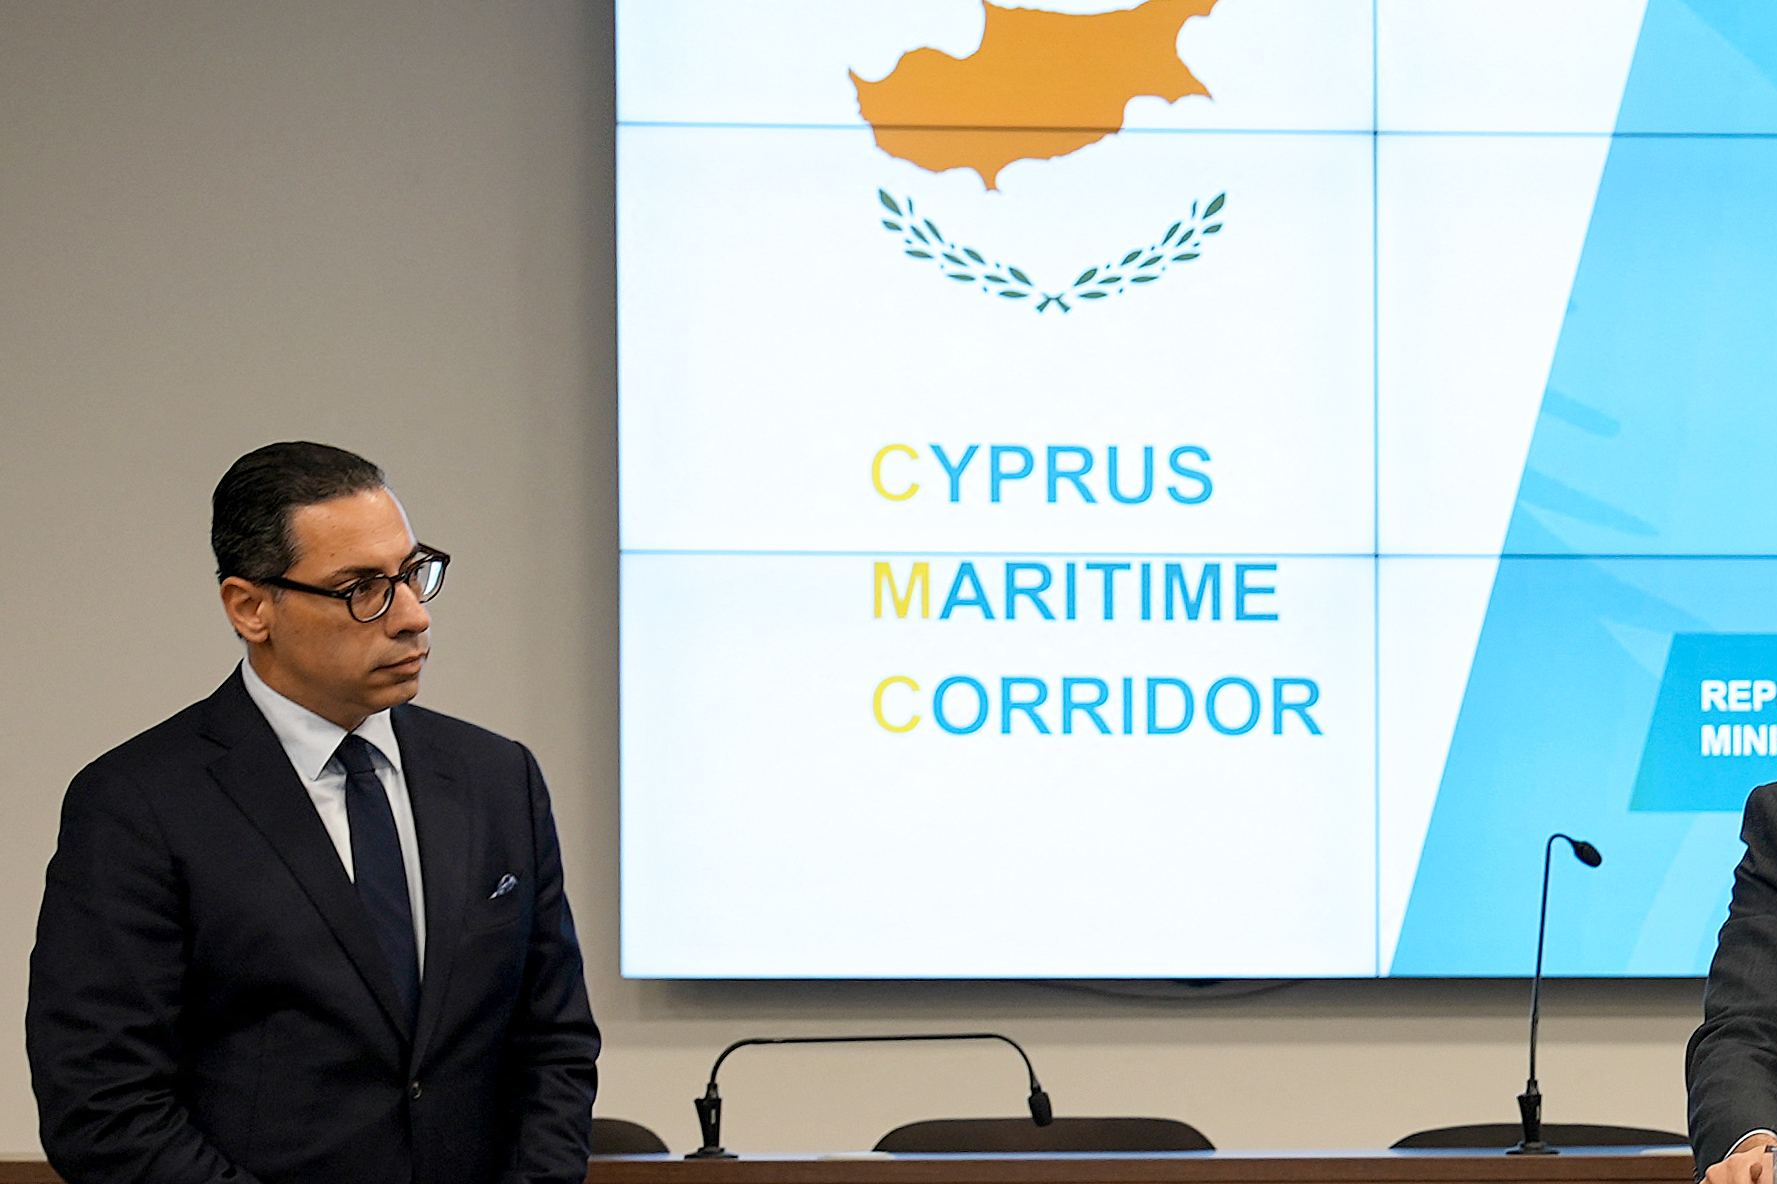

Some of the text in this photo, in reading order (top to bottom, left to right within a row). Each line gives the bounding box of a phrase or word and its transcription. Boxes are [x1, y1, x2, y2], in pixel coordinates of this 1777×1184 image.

[871, 443, 1214, 505] CYPRUS
[872, 561, 1280, 622] MARITIME
[872, 675, 1324, 736] CORRIDOR
